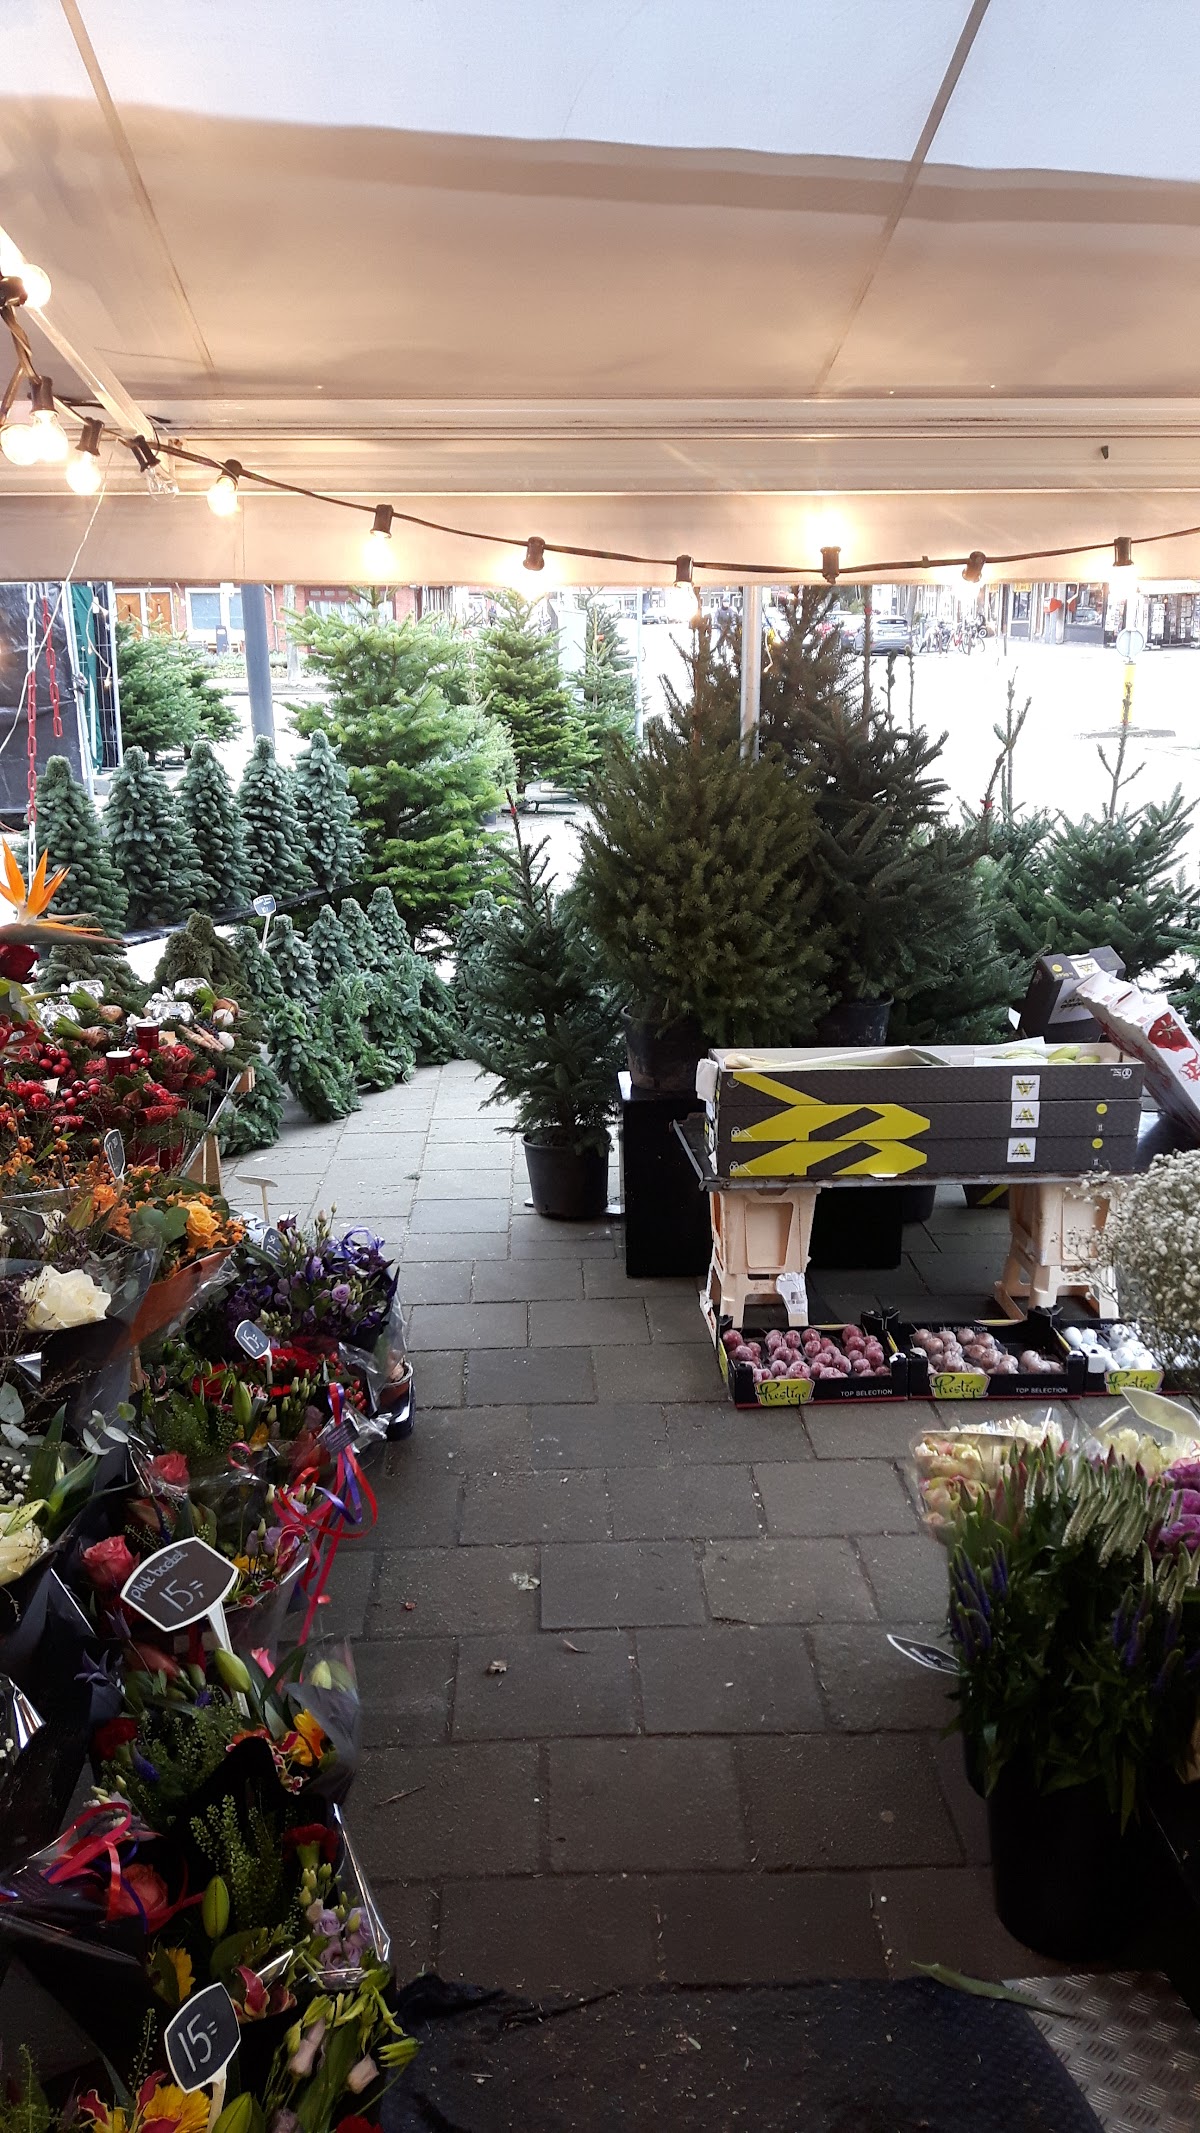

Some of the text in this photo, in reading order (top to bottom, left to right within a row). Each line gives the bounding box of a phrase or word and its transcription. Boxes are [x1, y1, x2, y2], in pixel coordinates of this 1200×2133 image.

[756, 1381, 807, 1405] Prestige
[840, 1388, 893, 1398] TOP SELECTION
[931, 1374, 983, 1399] Prestige
